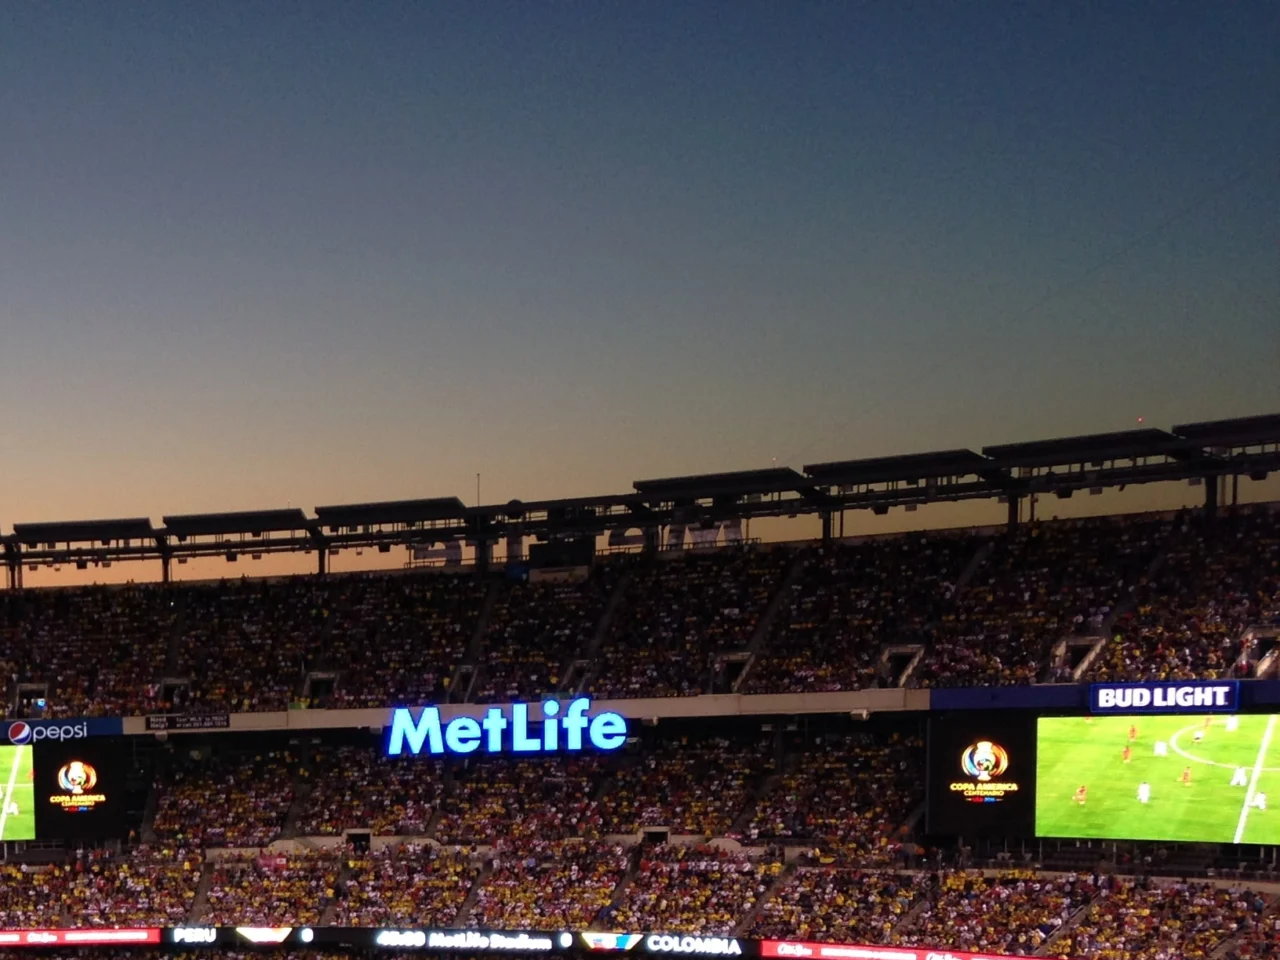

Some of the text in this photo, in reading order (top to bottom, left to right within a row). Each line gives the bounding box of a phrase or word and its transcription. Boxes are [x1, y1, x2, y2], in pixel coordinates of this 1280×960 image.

[1098, 686, 1230, 707] BUD LIGHT
[33, 722, 87, 742] pepsi
[388, 698, 626, 754] MetLife
[647, 935, 742, 955] COLOMBIA
